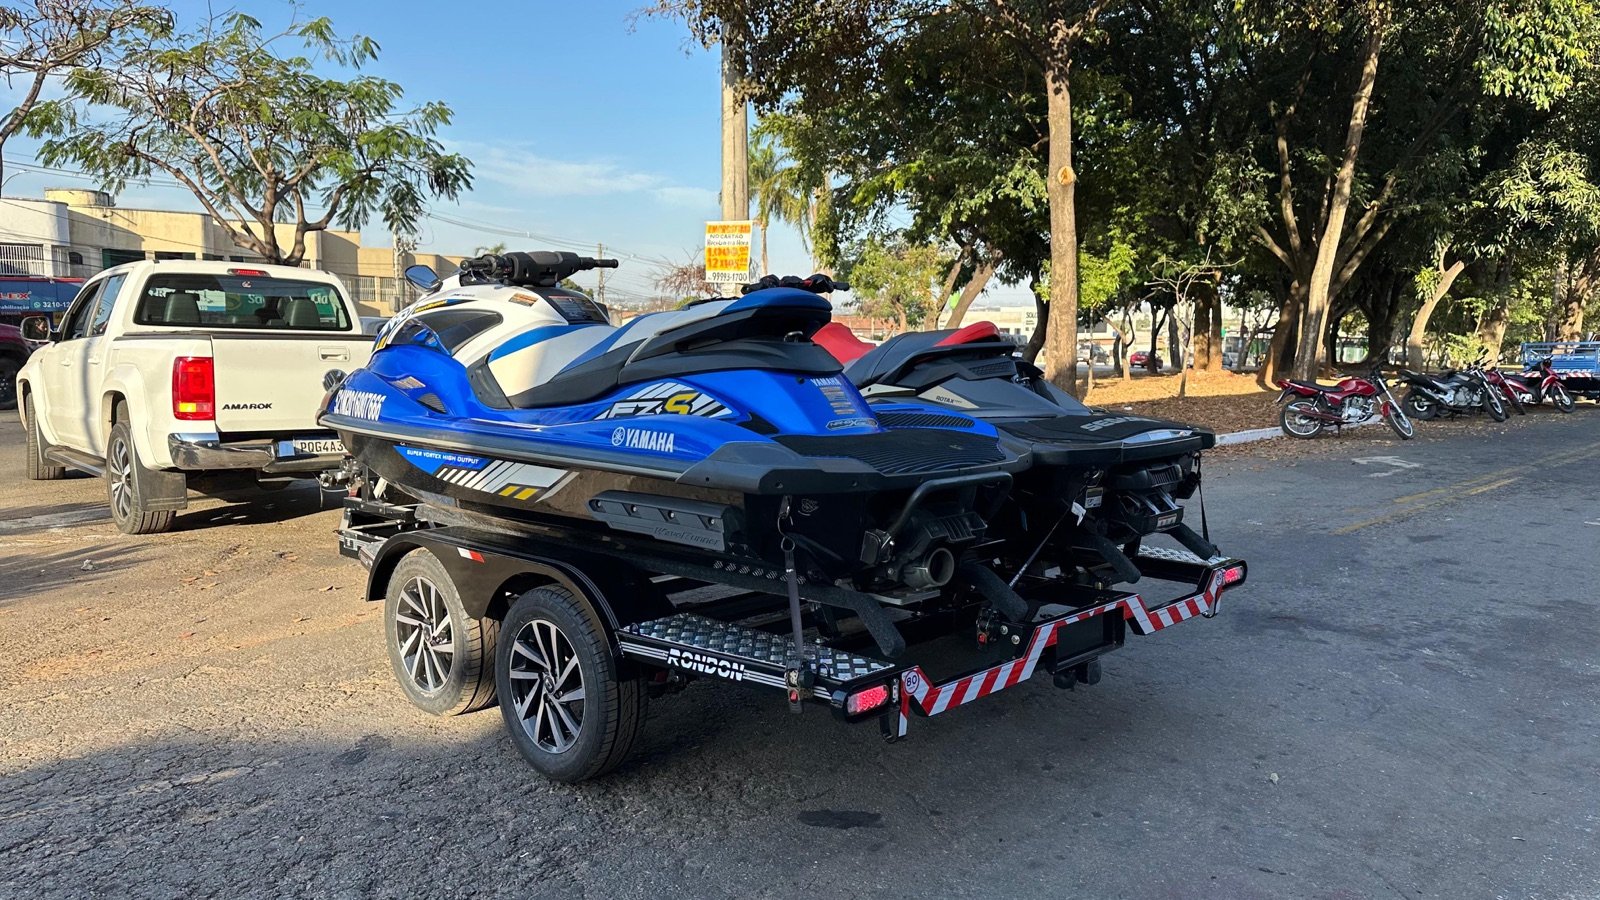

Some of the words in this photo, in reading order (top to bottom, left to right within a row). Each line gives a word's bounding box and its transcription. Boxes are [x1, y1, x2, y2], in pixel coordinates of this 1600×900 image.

[810, 377, 842, 387] YAMAHA
[222, 402, 273, 410] AMAROK
[625, 428, 675, 453] YAMAHA
[406, 449, 422, 457] SUPER
[423, 452, 442, 460] VORTEX
[442, 454, 456, 462] HIGH
[457, 456, 479, 465] OUTPUT
[667, 648, 745, 682] RONDON
[906, 674, 918, 687] 80
